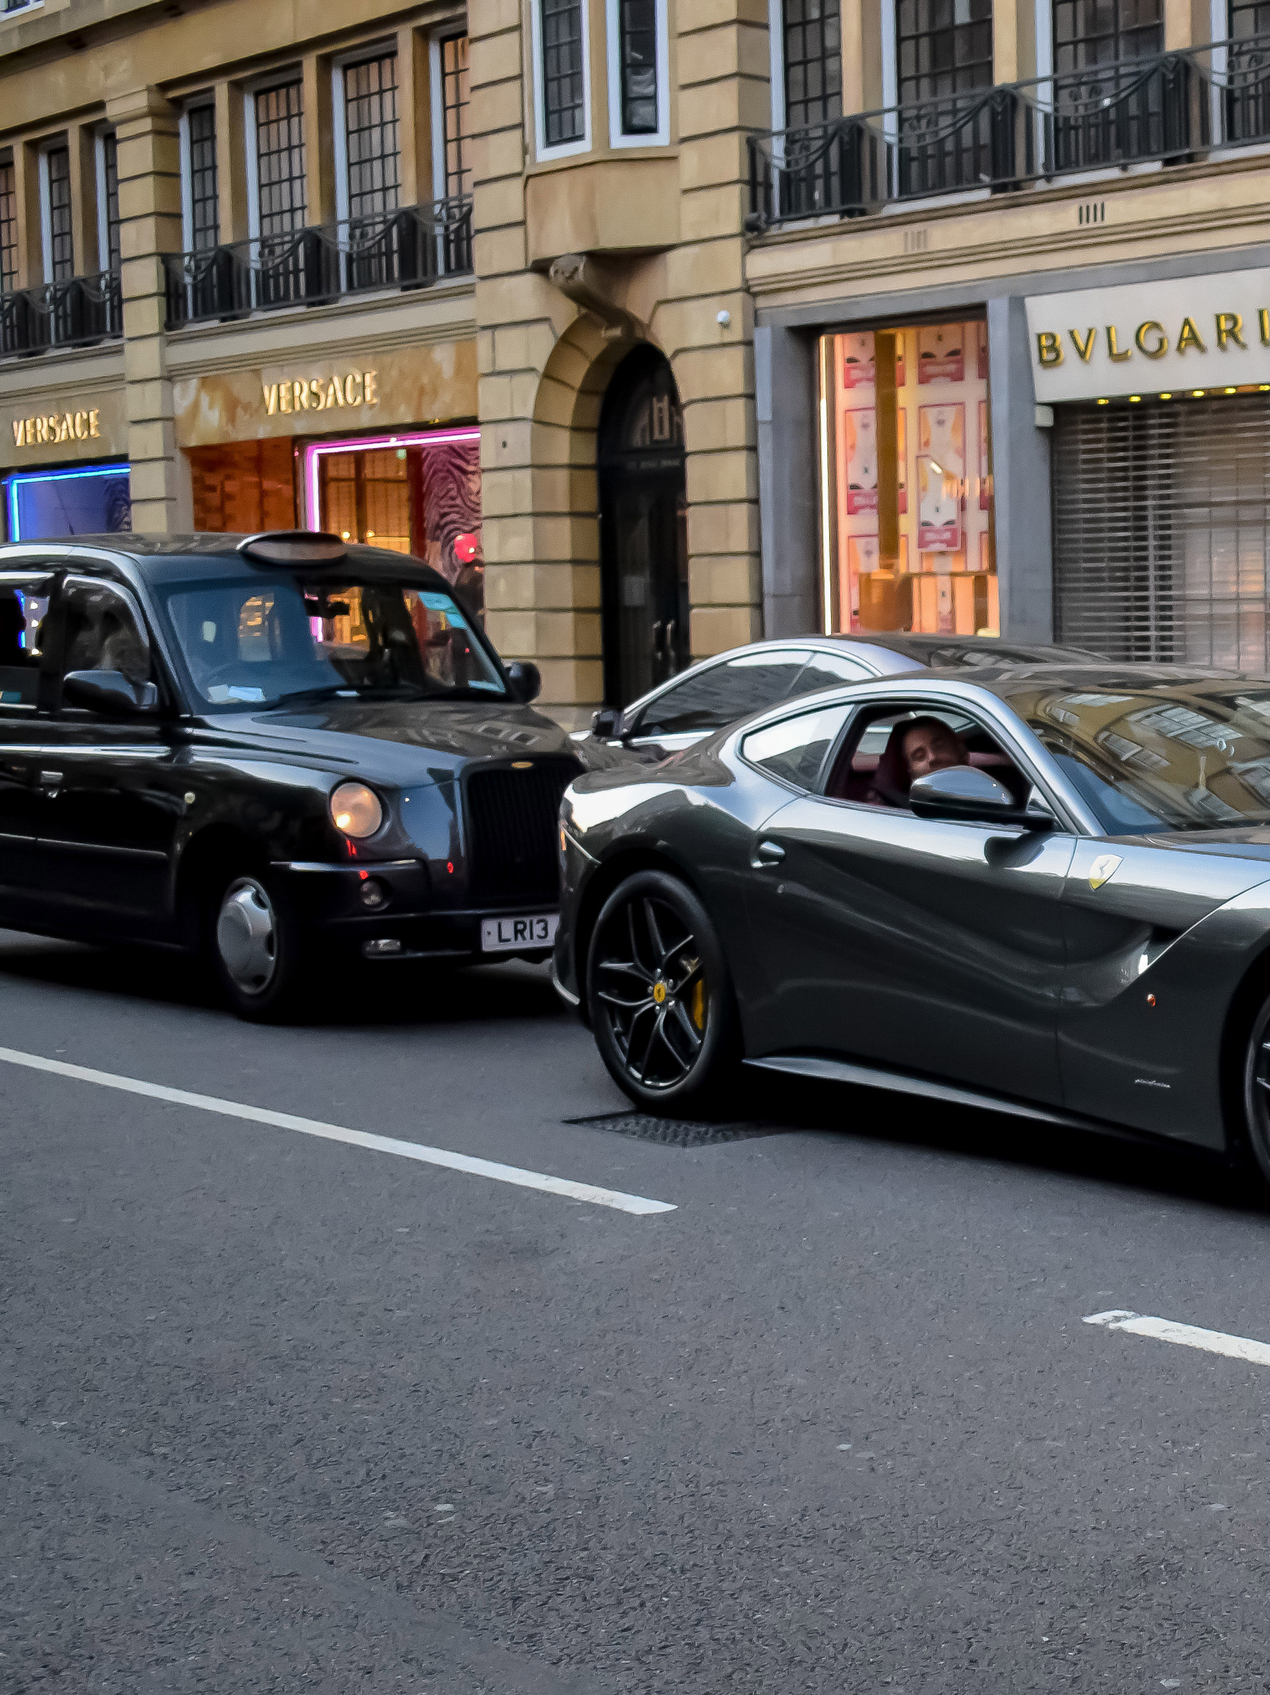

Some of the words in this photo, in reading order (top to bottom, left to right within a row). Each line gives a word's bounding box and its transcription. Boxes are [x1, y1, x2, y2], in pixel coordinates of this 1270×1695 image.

[1036, 308, 1270, 369] BVLGARI
[262, 370, 378, 416] VERSACE
[12, 409, 100, 446] VERSACE
[497, 918, 549, 943] LR13
